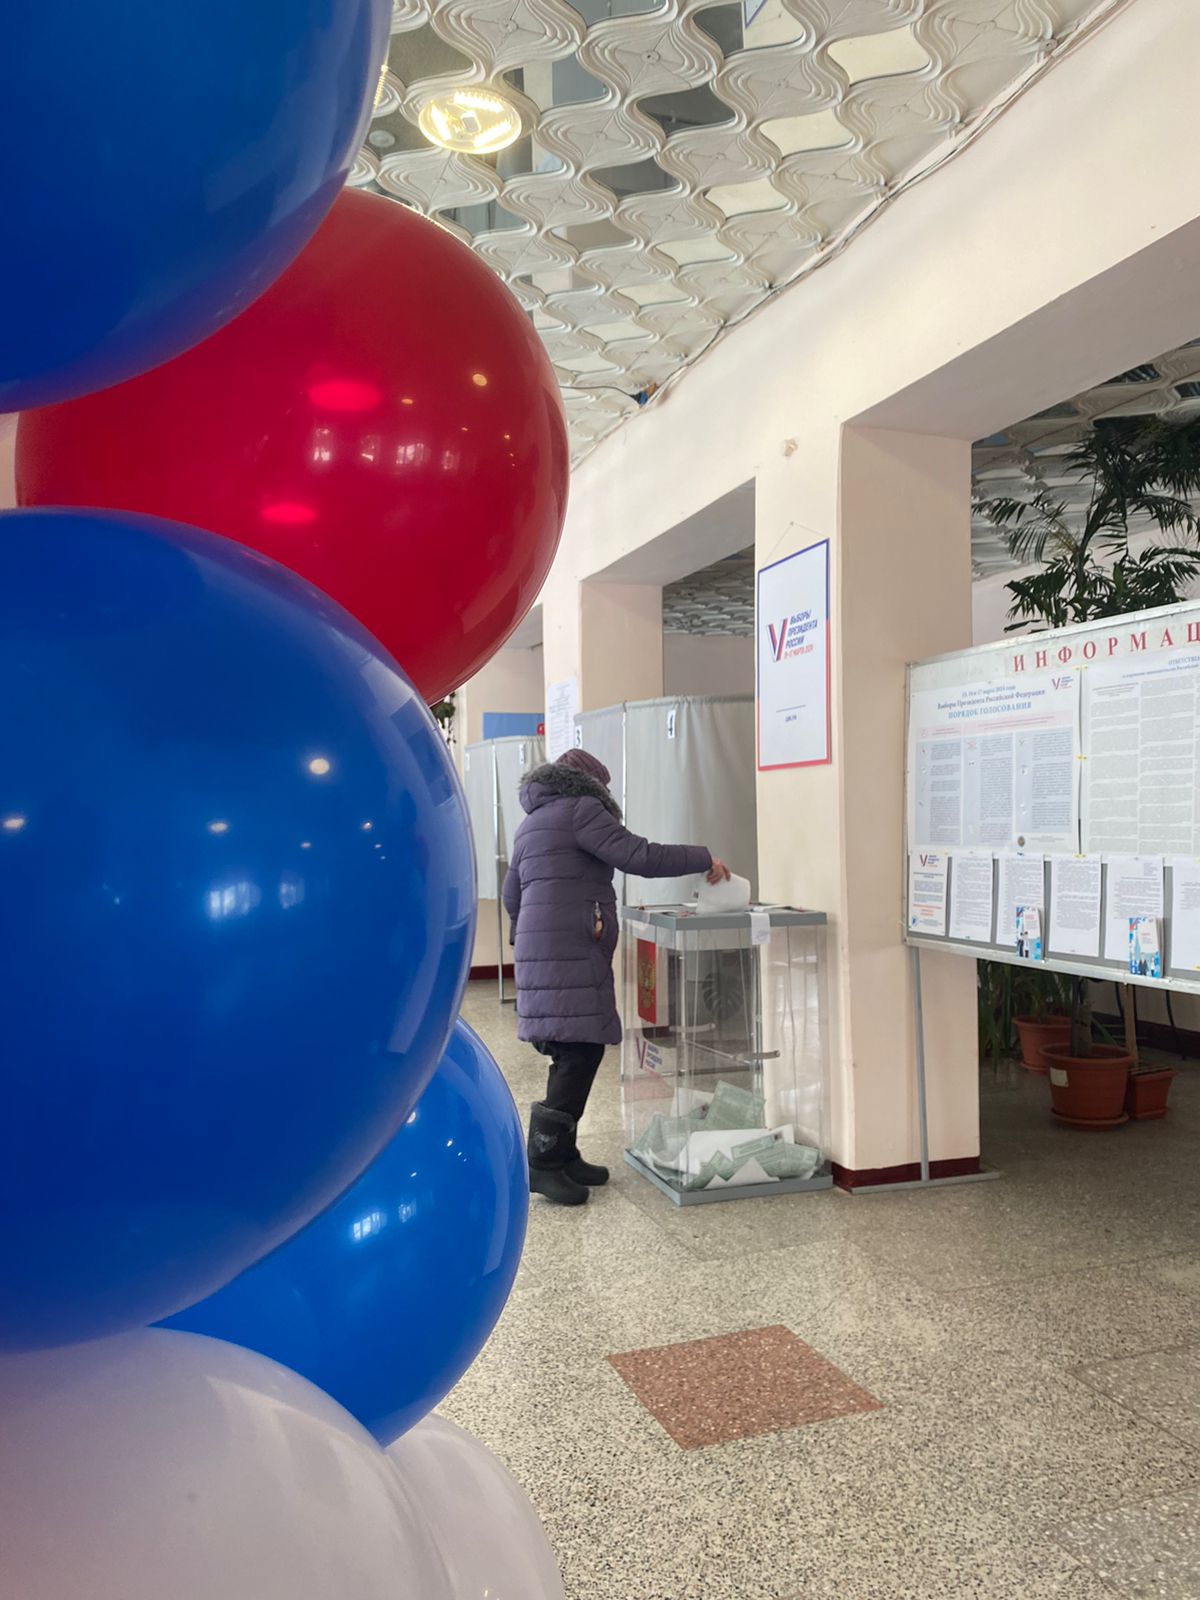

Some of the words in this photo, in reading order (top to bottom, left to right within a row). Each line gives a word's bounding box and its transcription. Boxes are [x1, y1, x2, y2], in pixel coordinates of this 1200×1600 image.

[790, 610, 811, 624] ВЫБОРЫ
[788, 619, 818, 637] ПРЕЗИДЕНТА
[786, 636, 804, 648] РОССИИ
[1013, 622, 1200, 673] ИНФОРМАЦ
[948, 708, 978, 719] ПОРЯДОК
[980, 701, 1032, 715] ГОЛОСОВАНИЯ
[668, 714, 674, 736] 4
